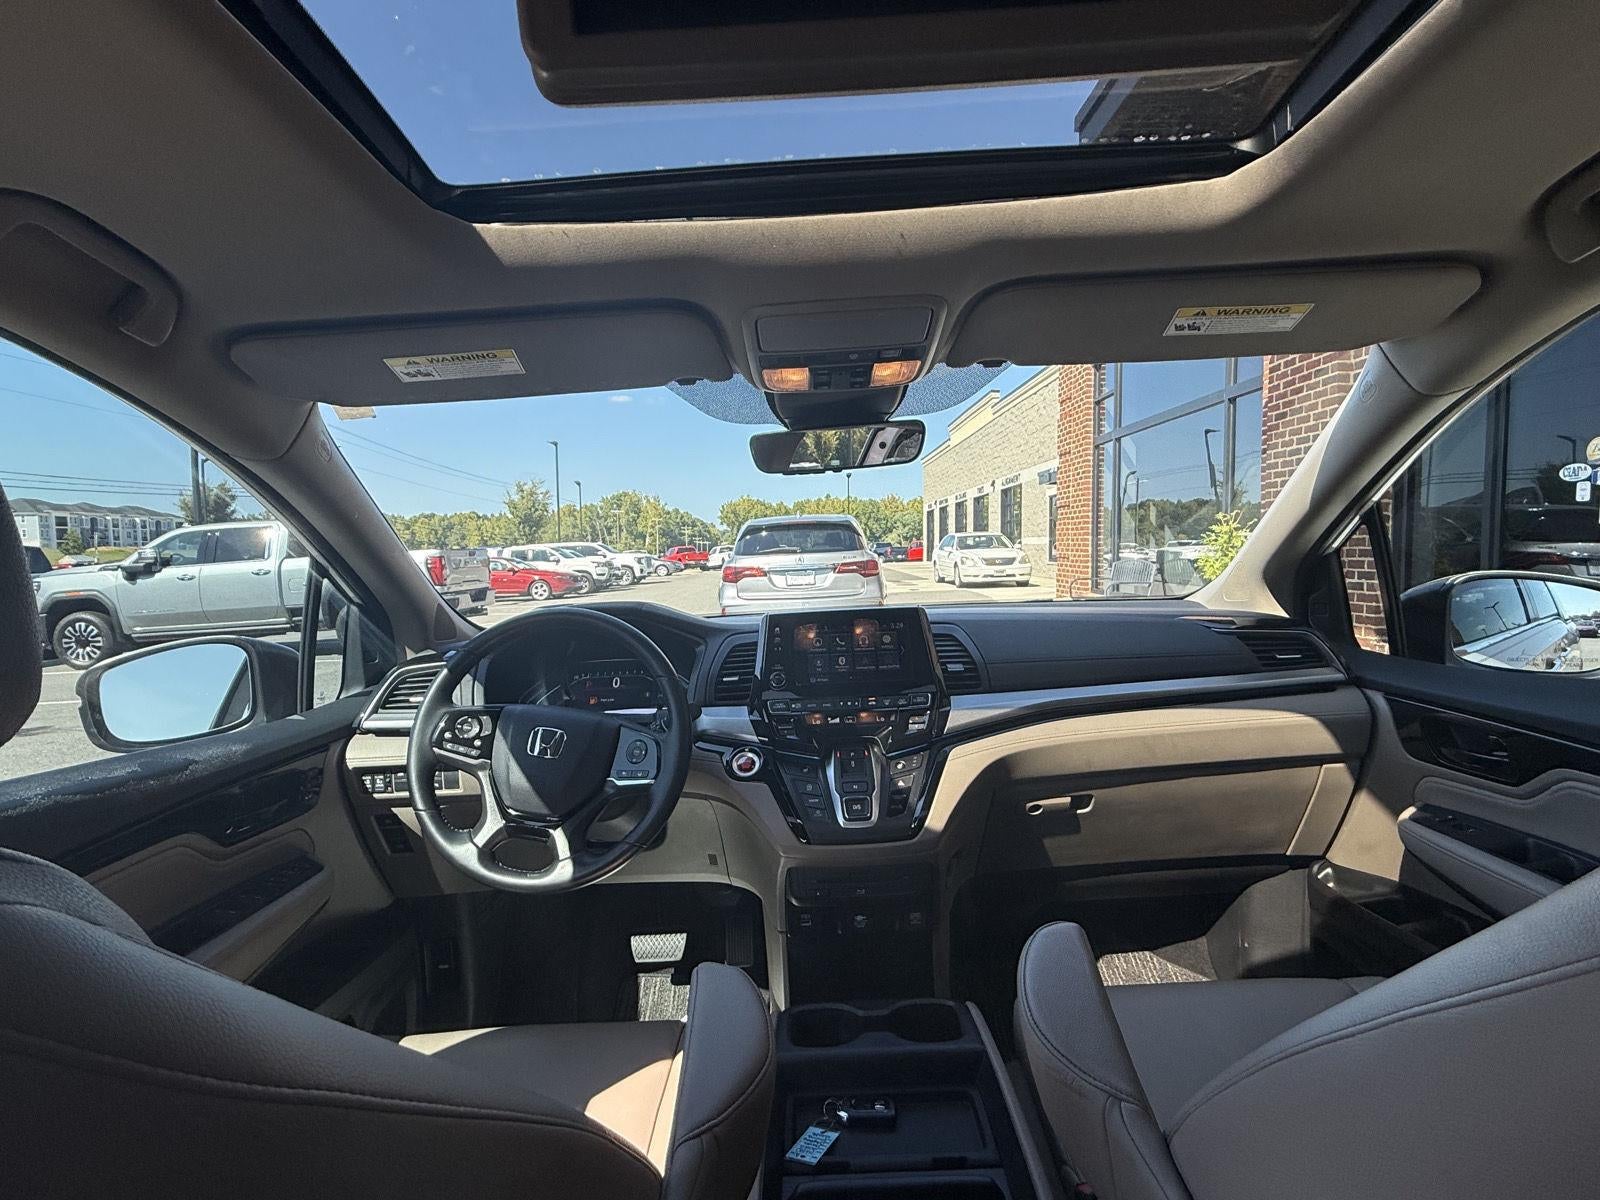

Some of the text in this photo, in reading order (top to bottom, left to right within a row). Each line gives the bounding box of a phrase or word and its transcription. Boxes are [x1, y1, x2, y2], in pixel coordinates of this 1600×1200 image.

[1216, 306, 1291, 316] WARNING
[427, 352, 497, 364] WARNING
[612, 677, 620, 688] 0
